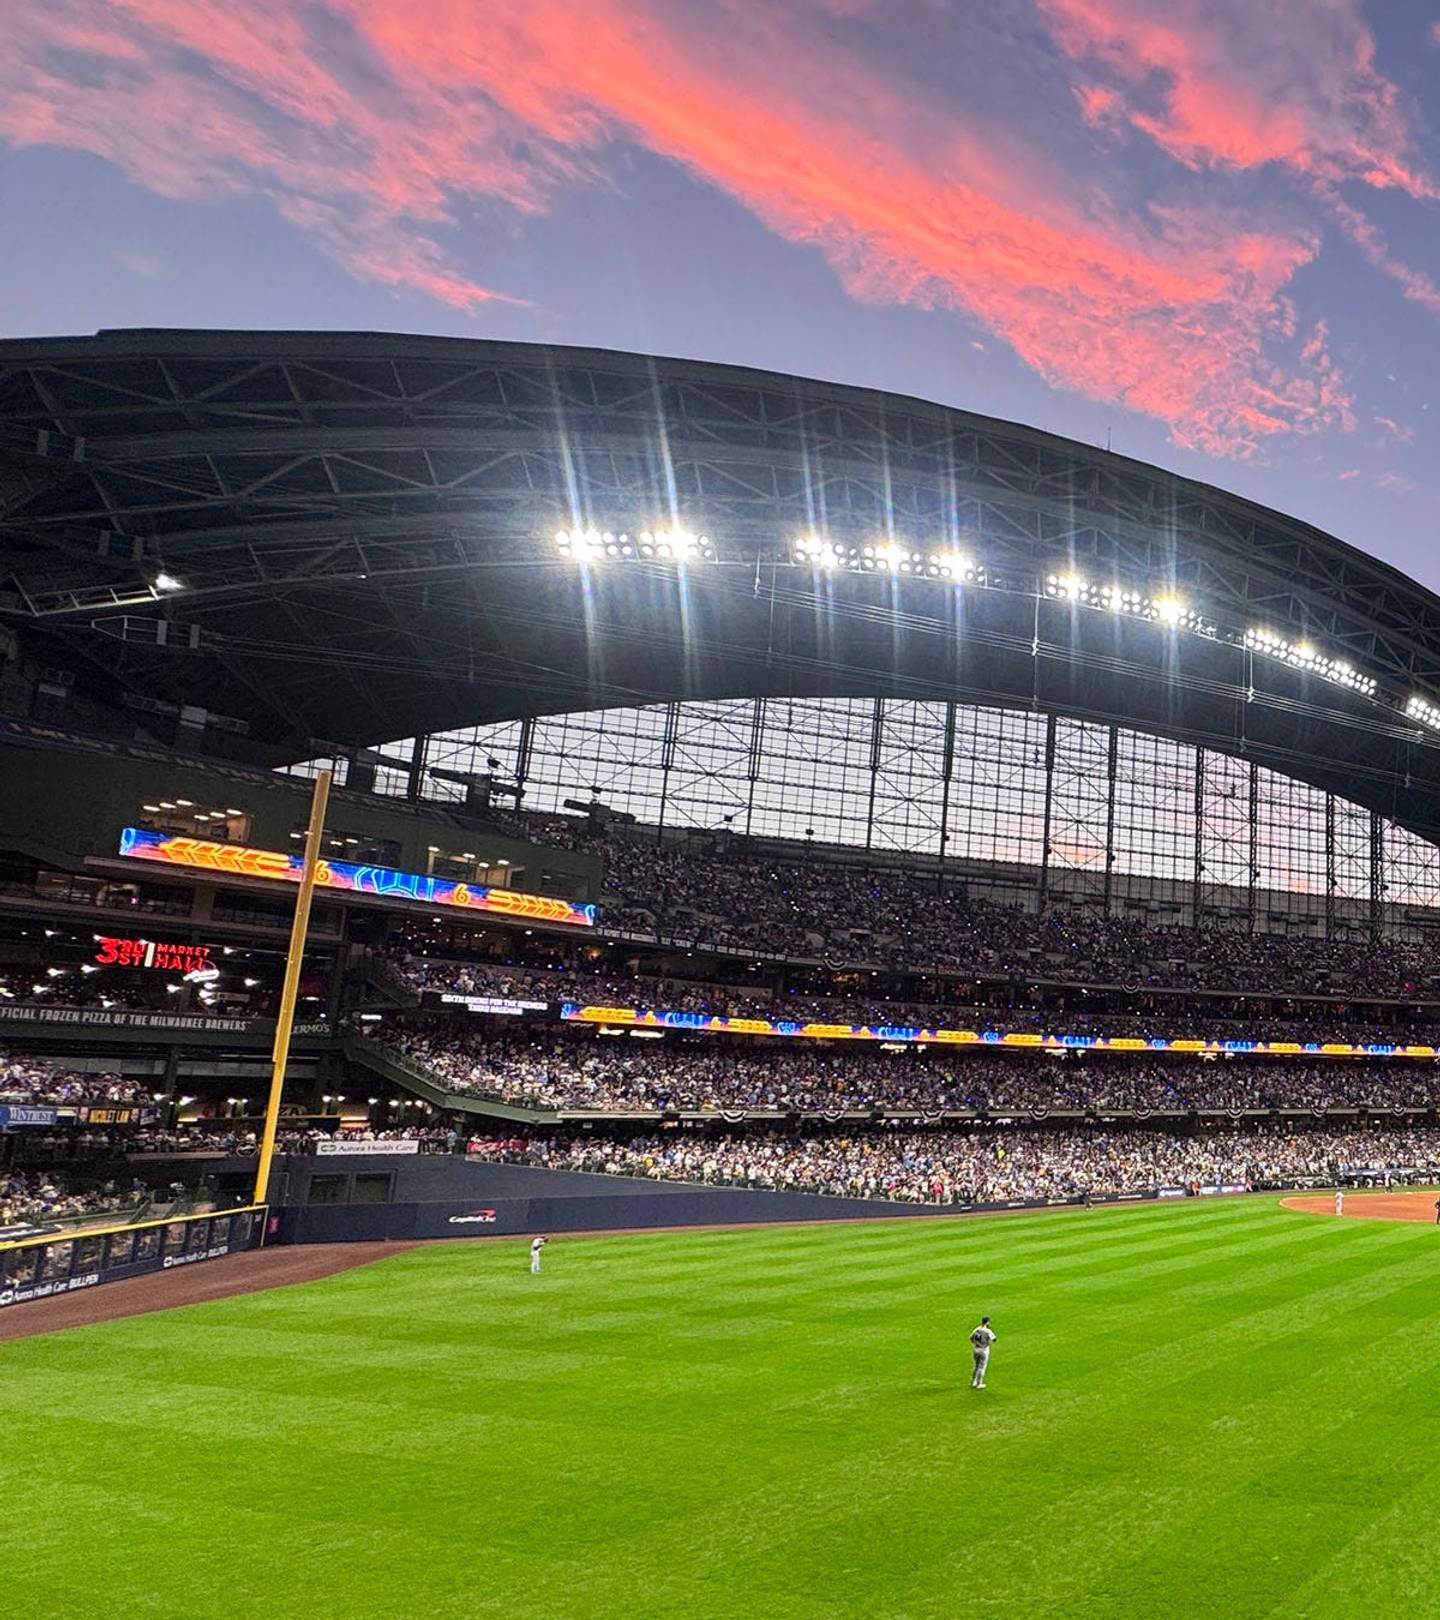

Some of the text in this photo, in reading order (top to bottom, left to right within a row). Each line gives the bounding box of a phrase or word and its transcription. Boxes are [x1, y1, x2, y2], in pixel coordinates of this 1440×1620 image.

[1, 1007, 36, 1020] FICIAL
[39, 1009, 79, 1022] FROZEN
[82, 1011, 111, 1024] PIZZA
[113, 1013, 127, 1024] OF
[129, 1015, 147, 1026] THE
[149, 1016, 203, 1029] MILWAUKEE
[69, 1273, 99, 1289] BULLPEN
